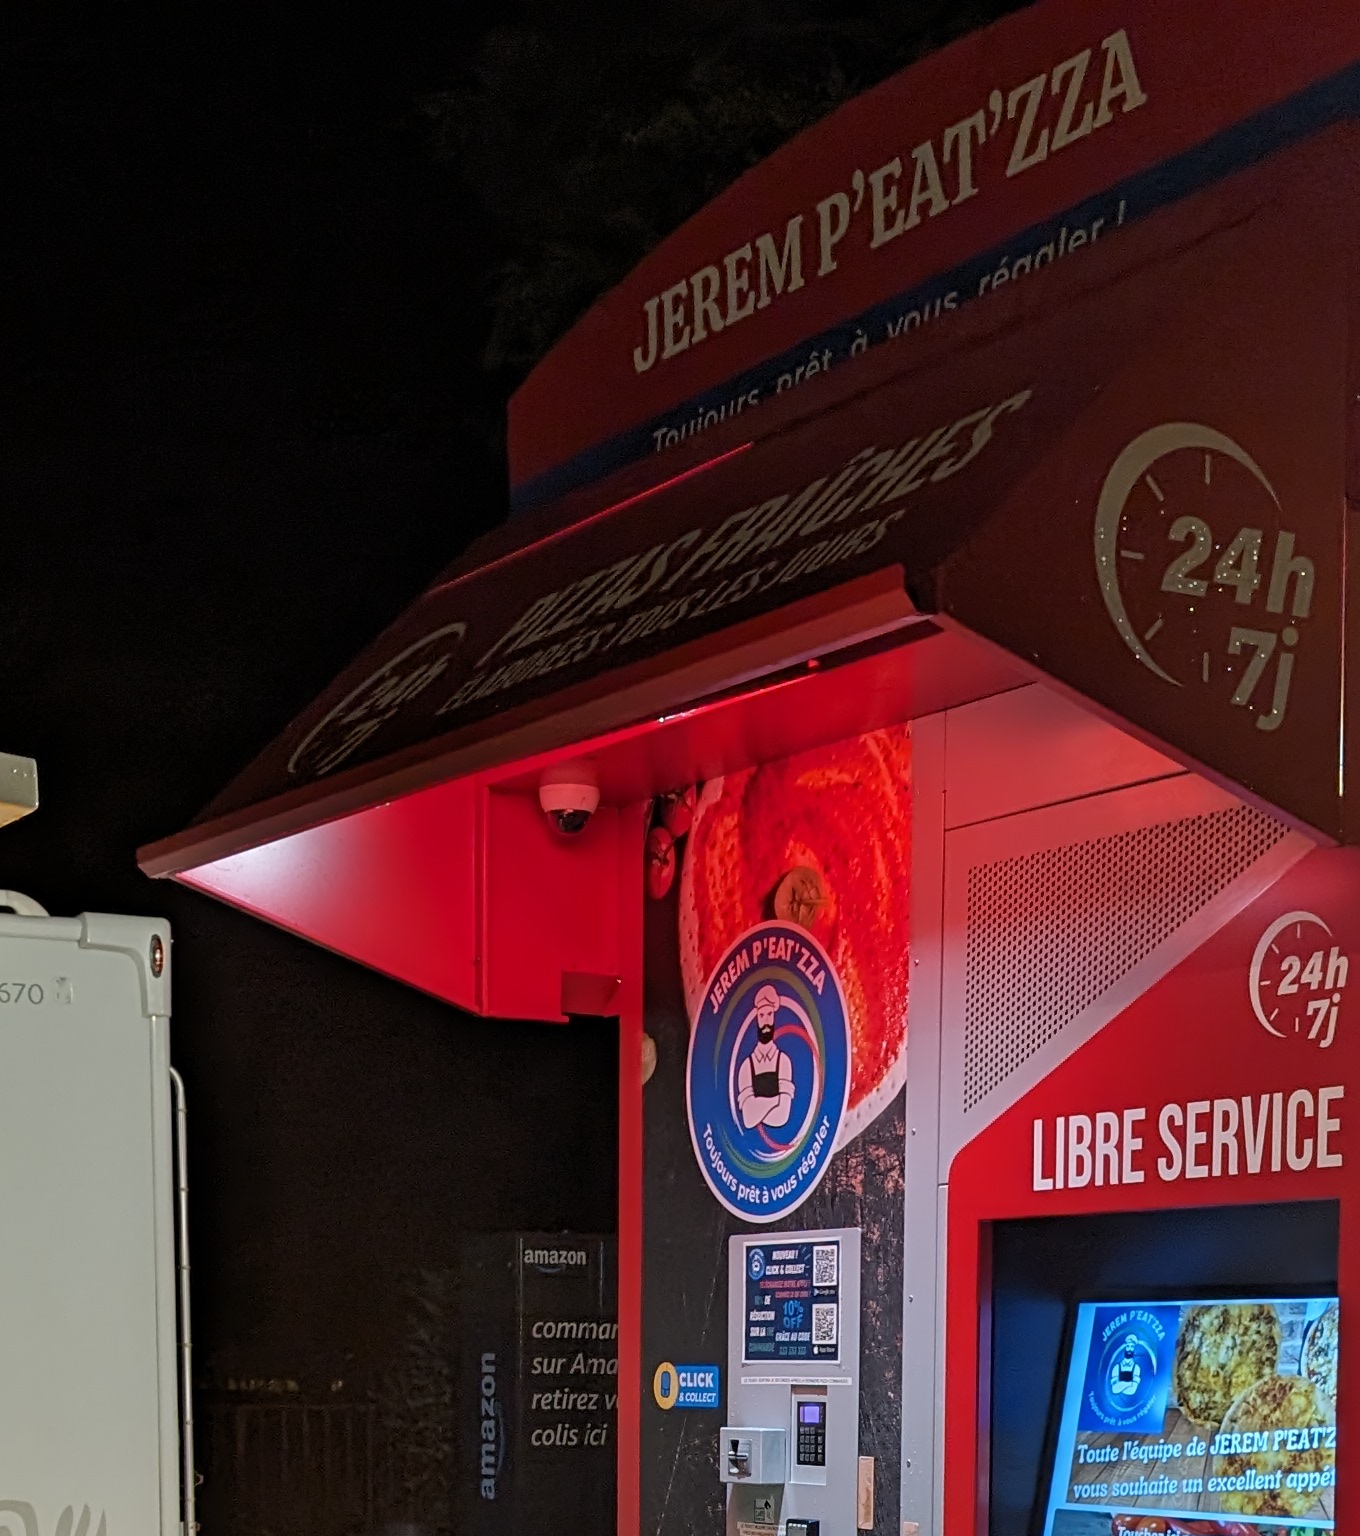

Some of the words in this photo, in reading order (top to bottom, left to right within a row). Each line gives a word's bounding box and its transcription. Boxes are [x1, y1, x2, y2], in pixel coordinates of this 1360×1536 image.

[633, 216, 805, 375] JEREM
[1158, 513, 1316, 619] 24h
[475, 530, 703, 668] PIZZAS
[1226, 626, 1301, 732] 7j
[710, 949, 749, 1014] JEREM
[1277, 947, 1349, 996] 24h
[1306, 994, 1340, 1048] 7j
[703, 1123, 737, 1192] Toujours
[739, 1184, 760, 1204] prêt
[762, 1186, 769, 1204] à
[771, 1177, 798, 1199] vous
[797, 1116, 830, 1180] régaler
[1033, 1107, 1146, 1192] LIBRE
[1157, 1086, 1344, 1182] SERVICE
[524, 1249, 587, 1265] amazon
[1102, 1313, 1127, 1341] JEREM
[532, 1357, 565, 1375] sur
[570, 1352, 618, 1375] Ama
[679, 1372, 714, 1388] CLICK
[532, 1388, 598, 1410] retirez
[686, 1391, 716, 1403] COLLECT
[481, 1353, 495, 1500] amazon
[532, 1423, 578, 1446] colis
[583, 1424, 607, 1446] ici
[1077, 1444, 1119, 1463] Toute
[1122, 1439, 1181, 1463] l'équipe
[1186, 1438, 1206, 1456] de
[1210, 1431, 1268, 1454] JEREM
[1073, 1484, 1108, 1499] vous
[1112, 1474, 1177, 1497] souhaite
[1182, 1478, 1202, 1493] un
[1207, 1469, 1282, 1492] excellent
